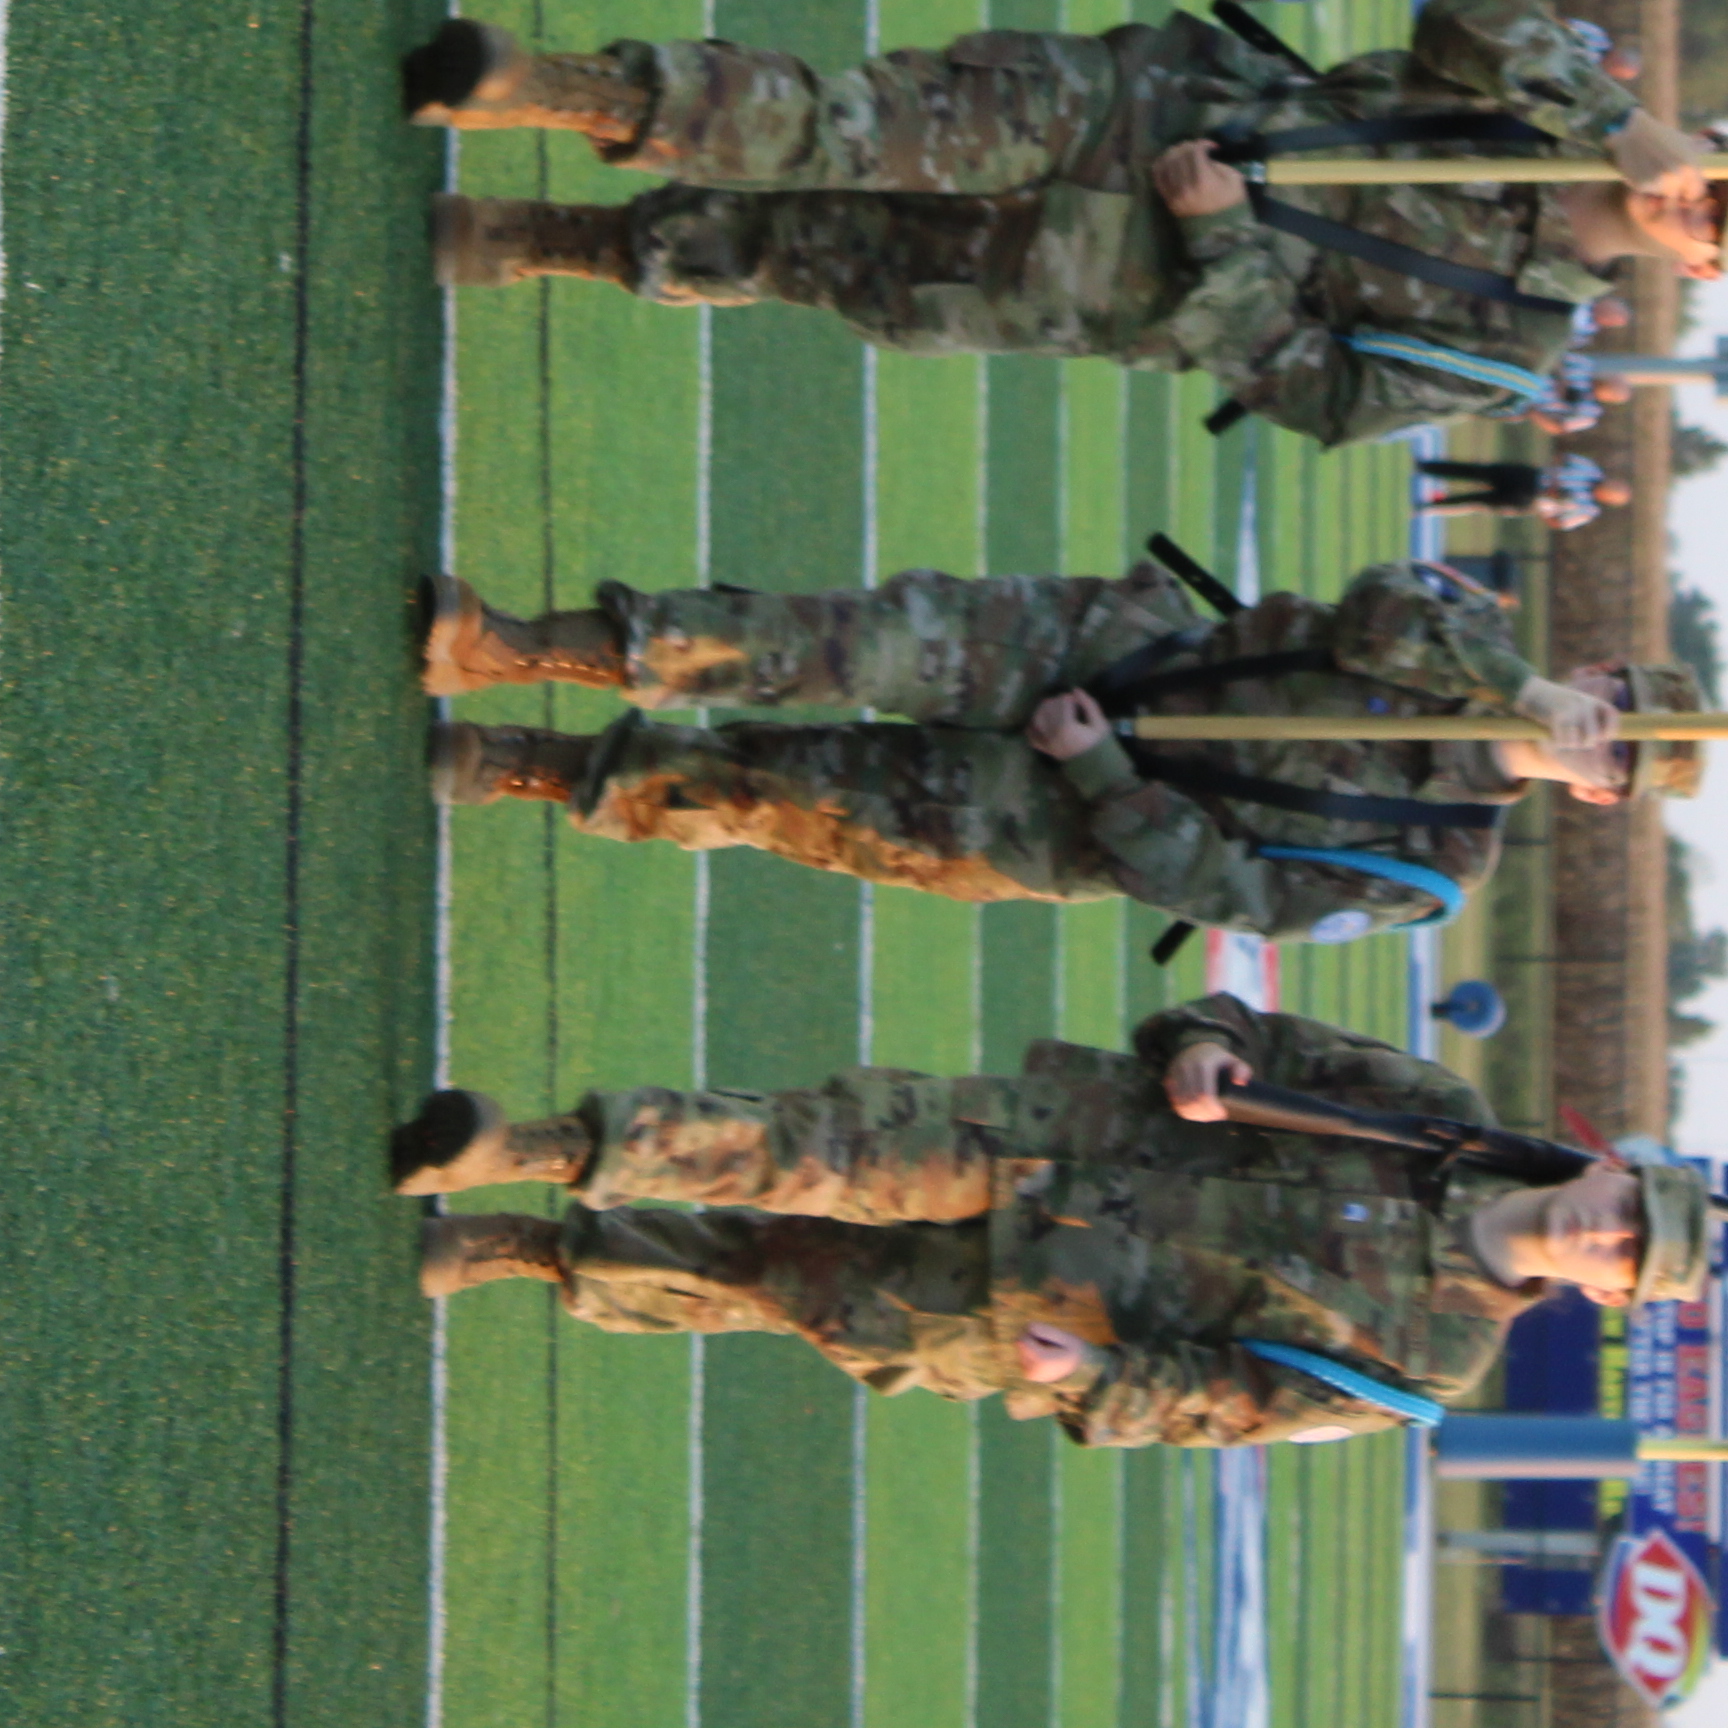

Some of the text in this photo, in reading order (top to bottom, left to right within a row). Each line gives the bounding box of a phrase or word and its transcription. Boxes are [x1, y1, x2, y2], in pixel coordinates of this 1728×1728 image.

[1675, 1302, 1708, 1532] O EAGES!
[1624, 1564, 1688, 1678] DQ
